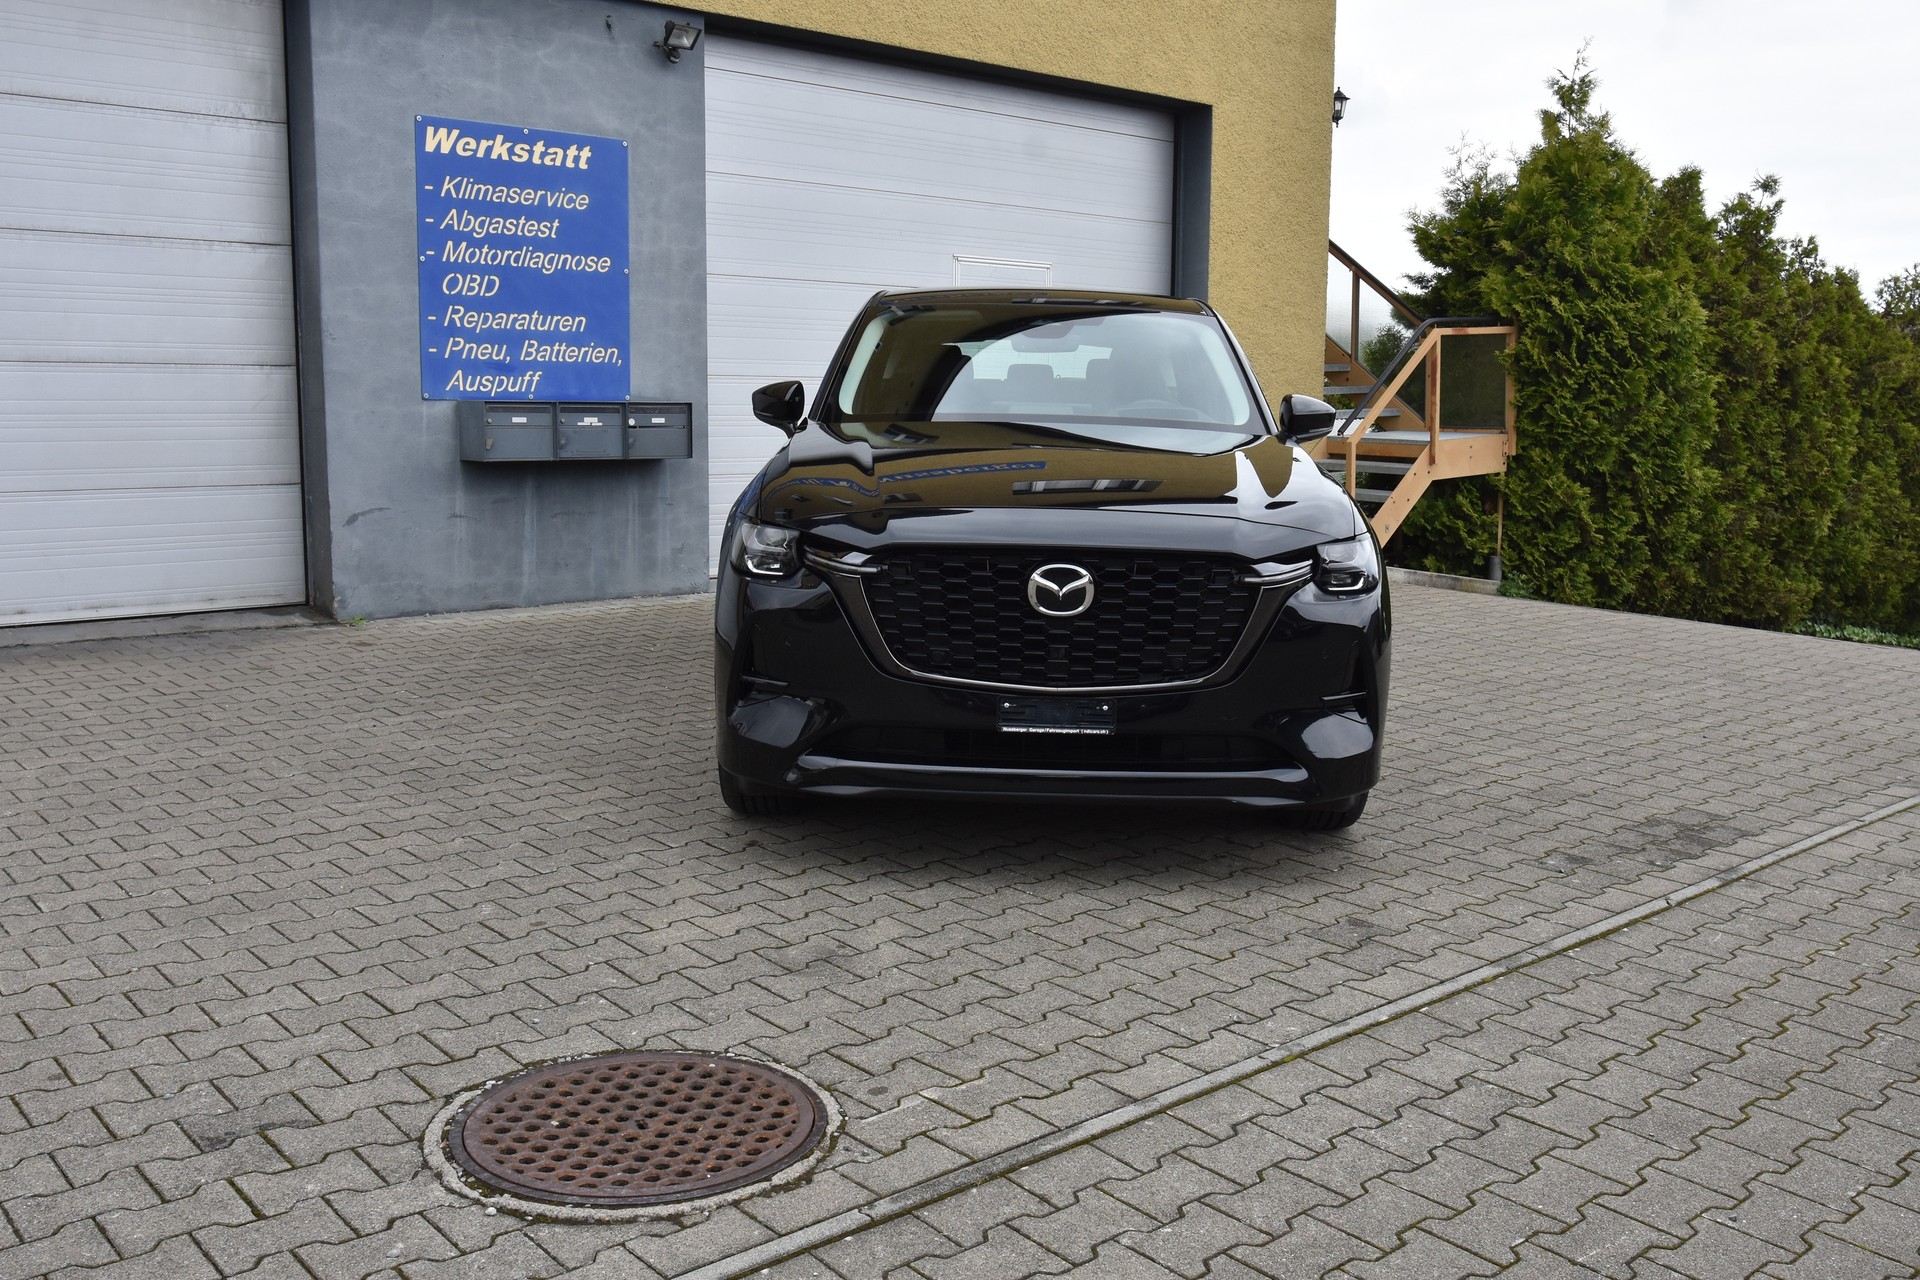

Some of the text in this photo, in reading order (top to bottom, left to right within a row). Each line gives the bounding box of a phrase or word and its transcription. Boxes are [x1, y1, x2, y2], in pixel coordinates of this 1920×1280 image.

[425, 126, 592, 169] Werkstatt
[440, 176, 590, 210] Klimaservice
[440, 209, 560, 239] Abgastest
[442, 241, 612, 275] Motordiagnose
[442, 272, 500, 297] OBD
[443, 306, 587, 334] Reparaturen
[444, 338, 511, 364] Pneu,
[520, 340, 623, 367] Batterien,
[446, 370, 543, 397] Auspuff
